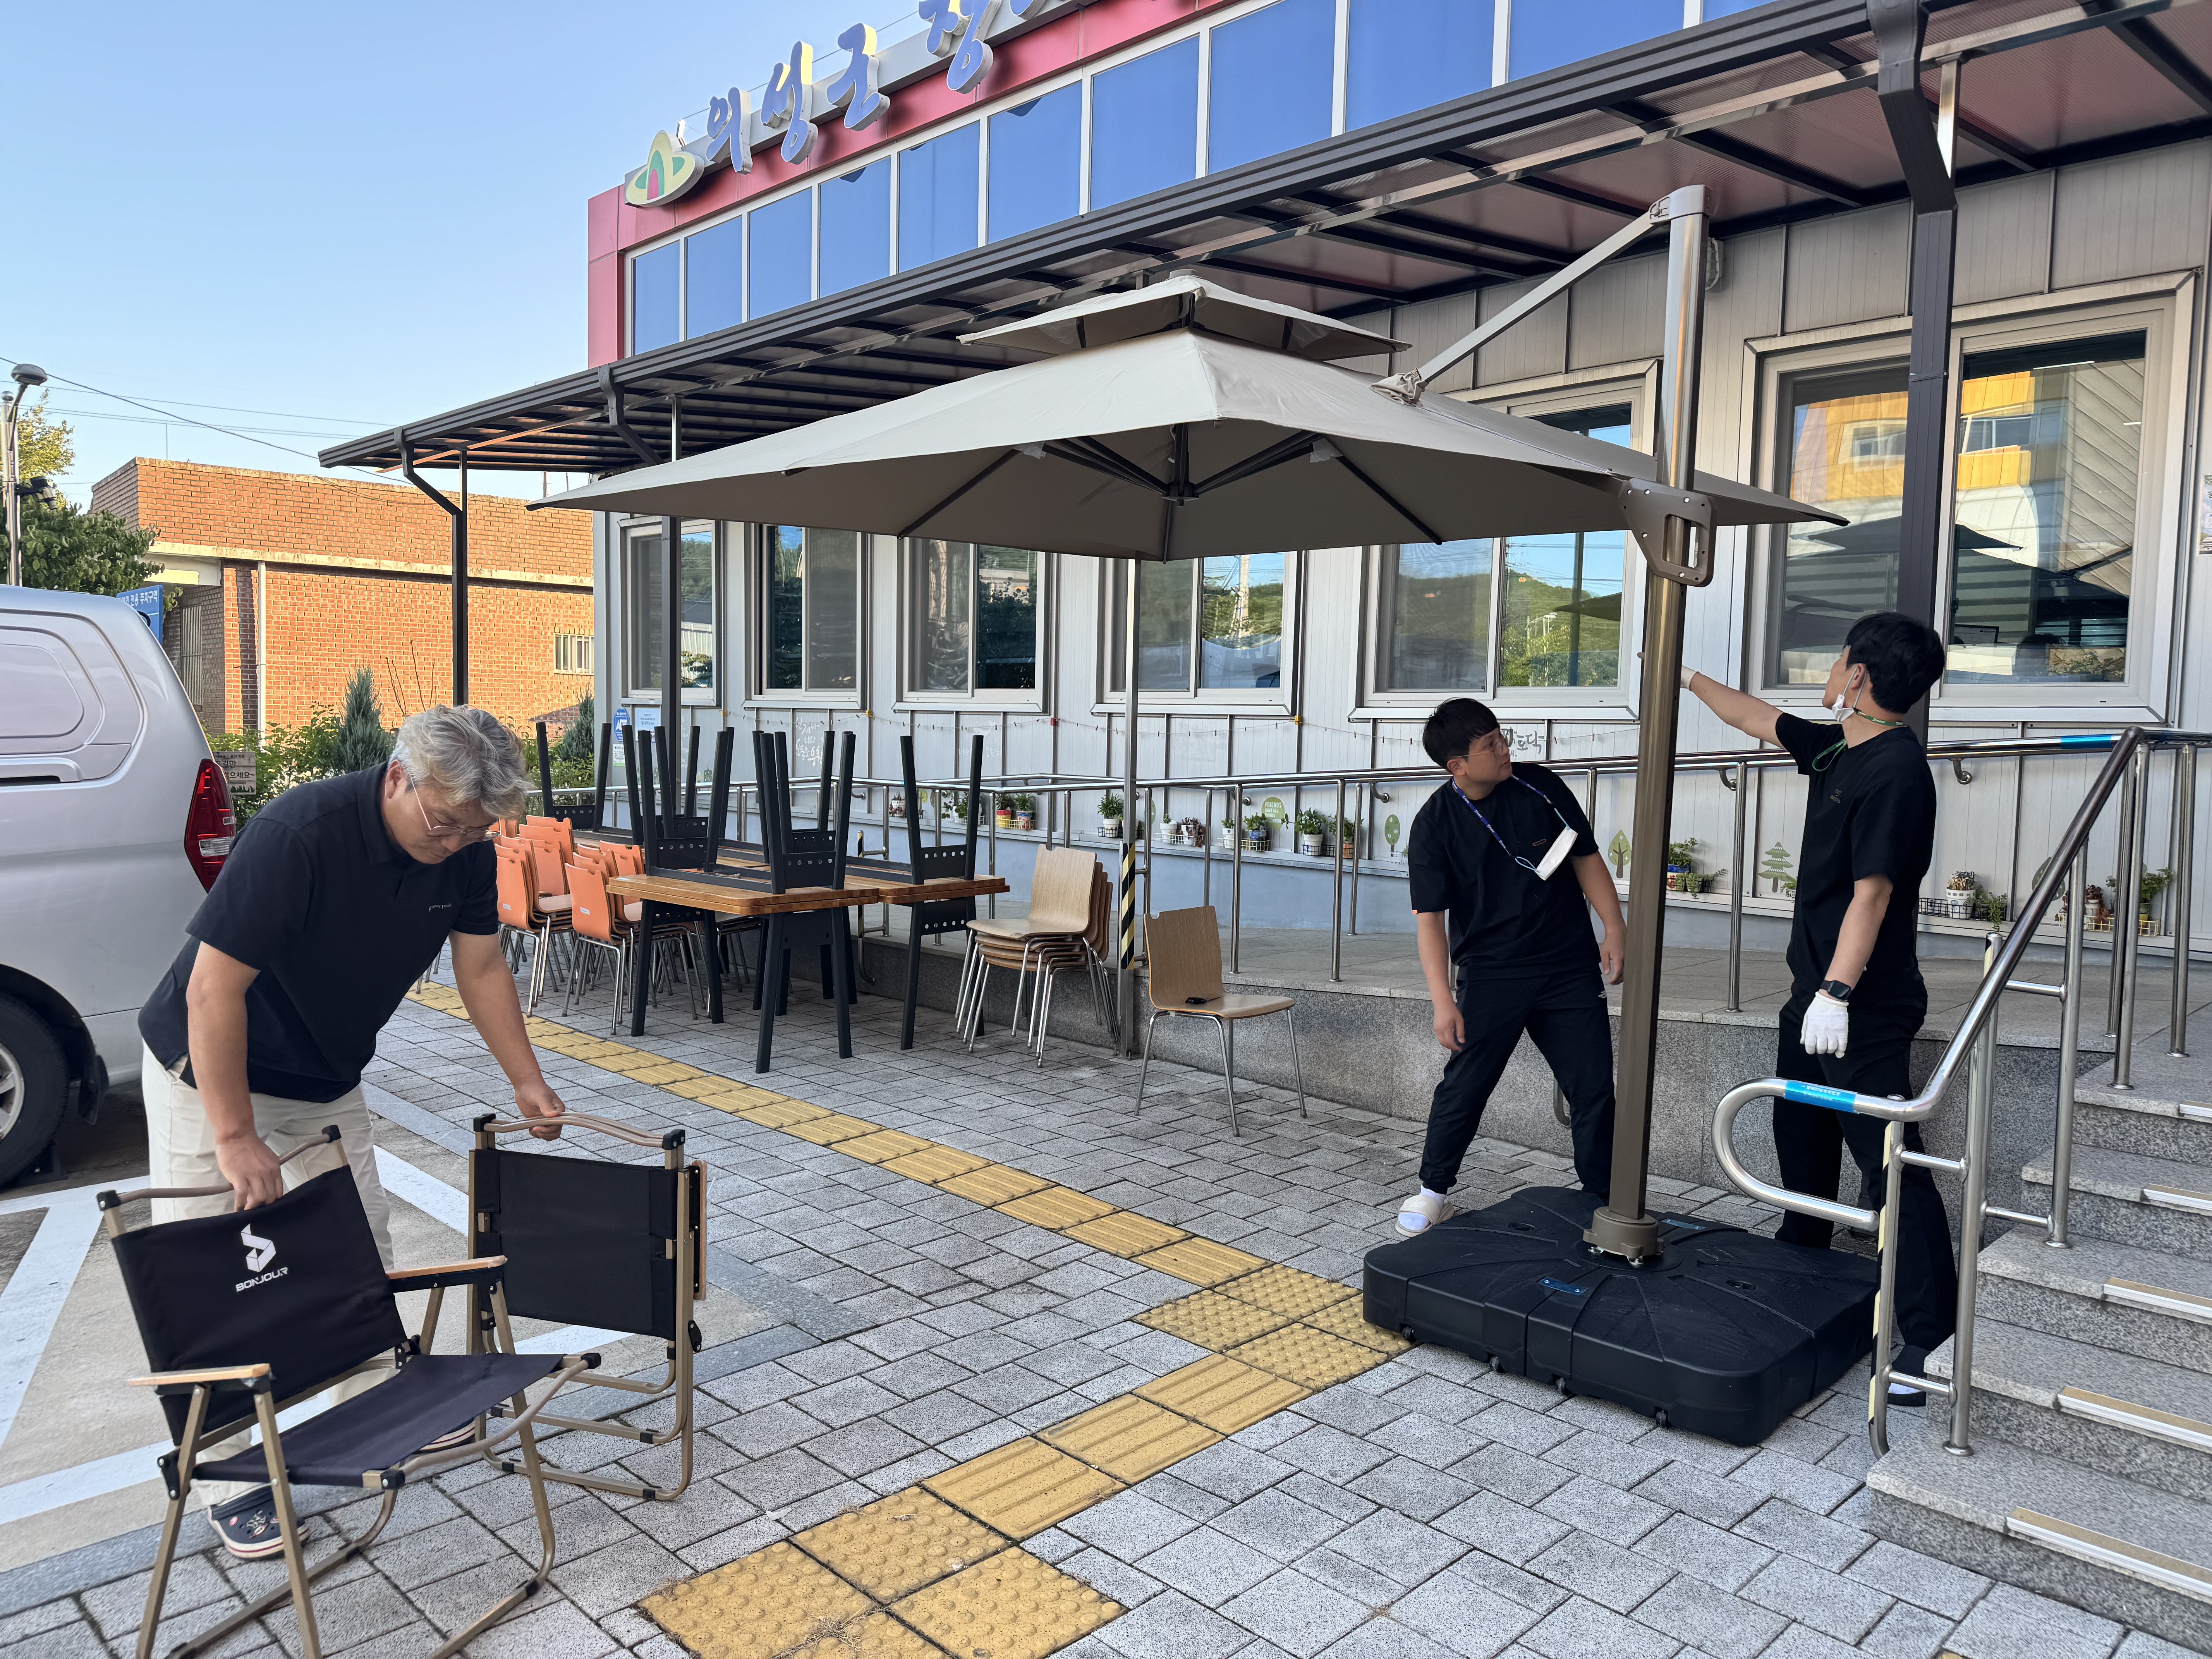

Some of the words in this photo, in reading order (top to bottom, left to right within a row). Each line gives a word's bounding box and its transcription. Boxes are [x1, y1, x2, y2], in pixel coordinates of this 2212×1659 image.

[706, 23, 890, 175] 의성군
[131, 593, 139, 606] 전용
[140, 590, 158, 605] 주차구역
[235, 1267, 288, 1292] BONJOUR
